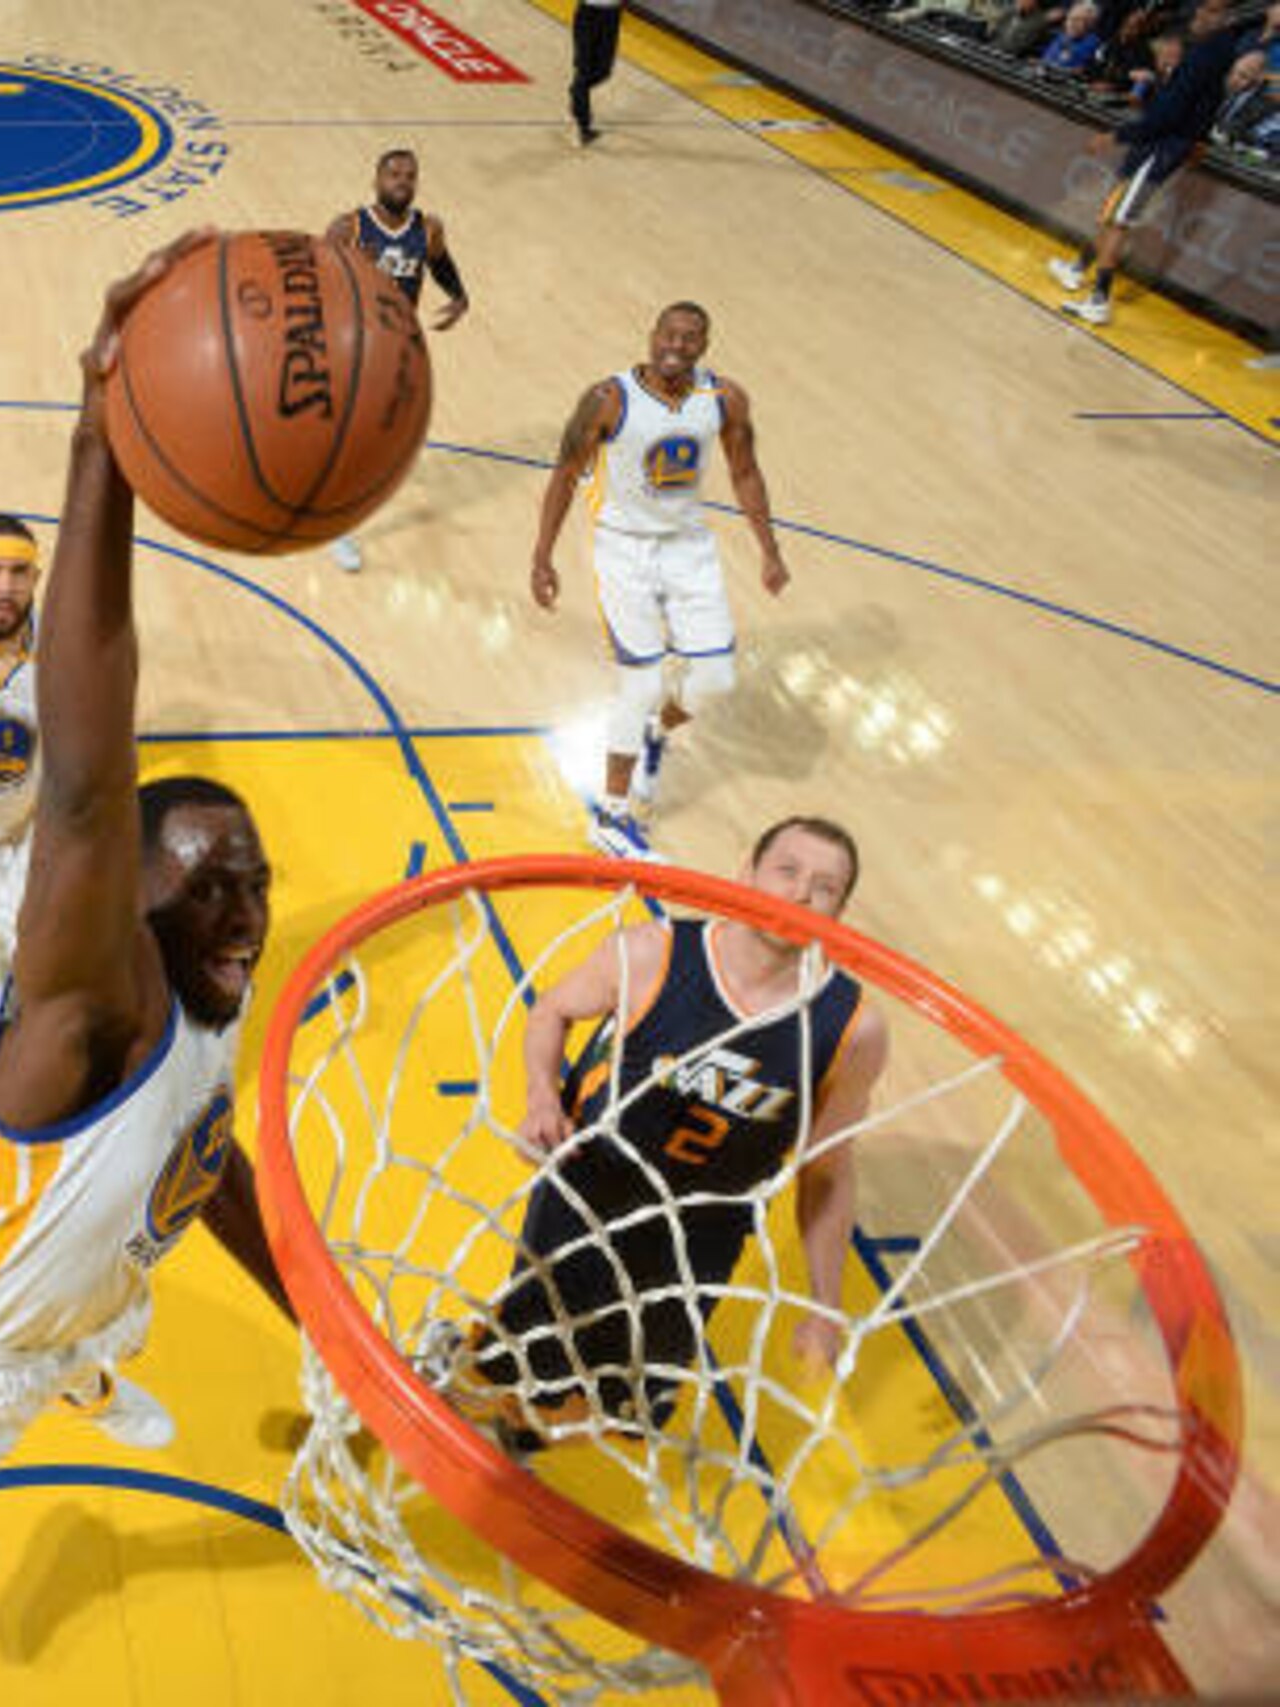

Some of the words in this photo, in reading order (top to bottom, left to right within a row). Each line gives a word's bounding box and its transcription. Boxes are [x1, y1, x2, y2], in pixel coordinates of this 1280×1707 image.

[261, 232, 333, 420] SPALDIN
[652, 1050, 796, 1121] JAZZ
[665, 1105, 730, 1165] 2
